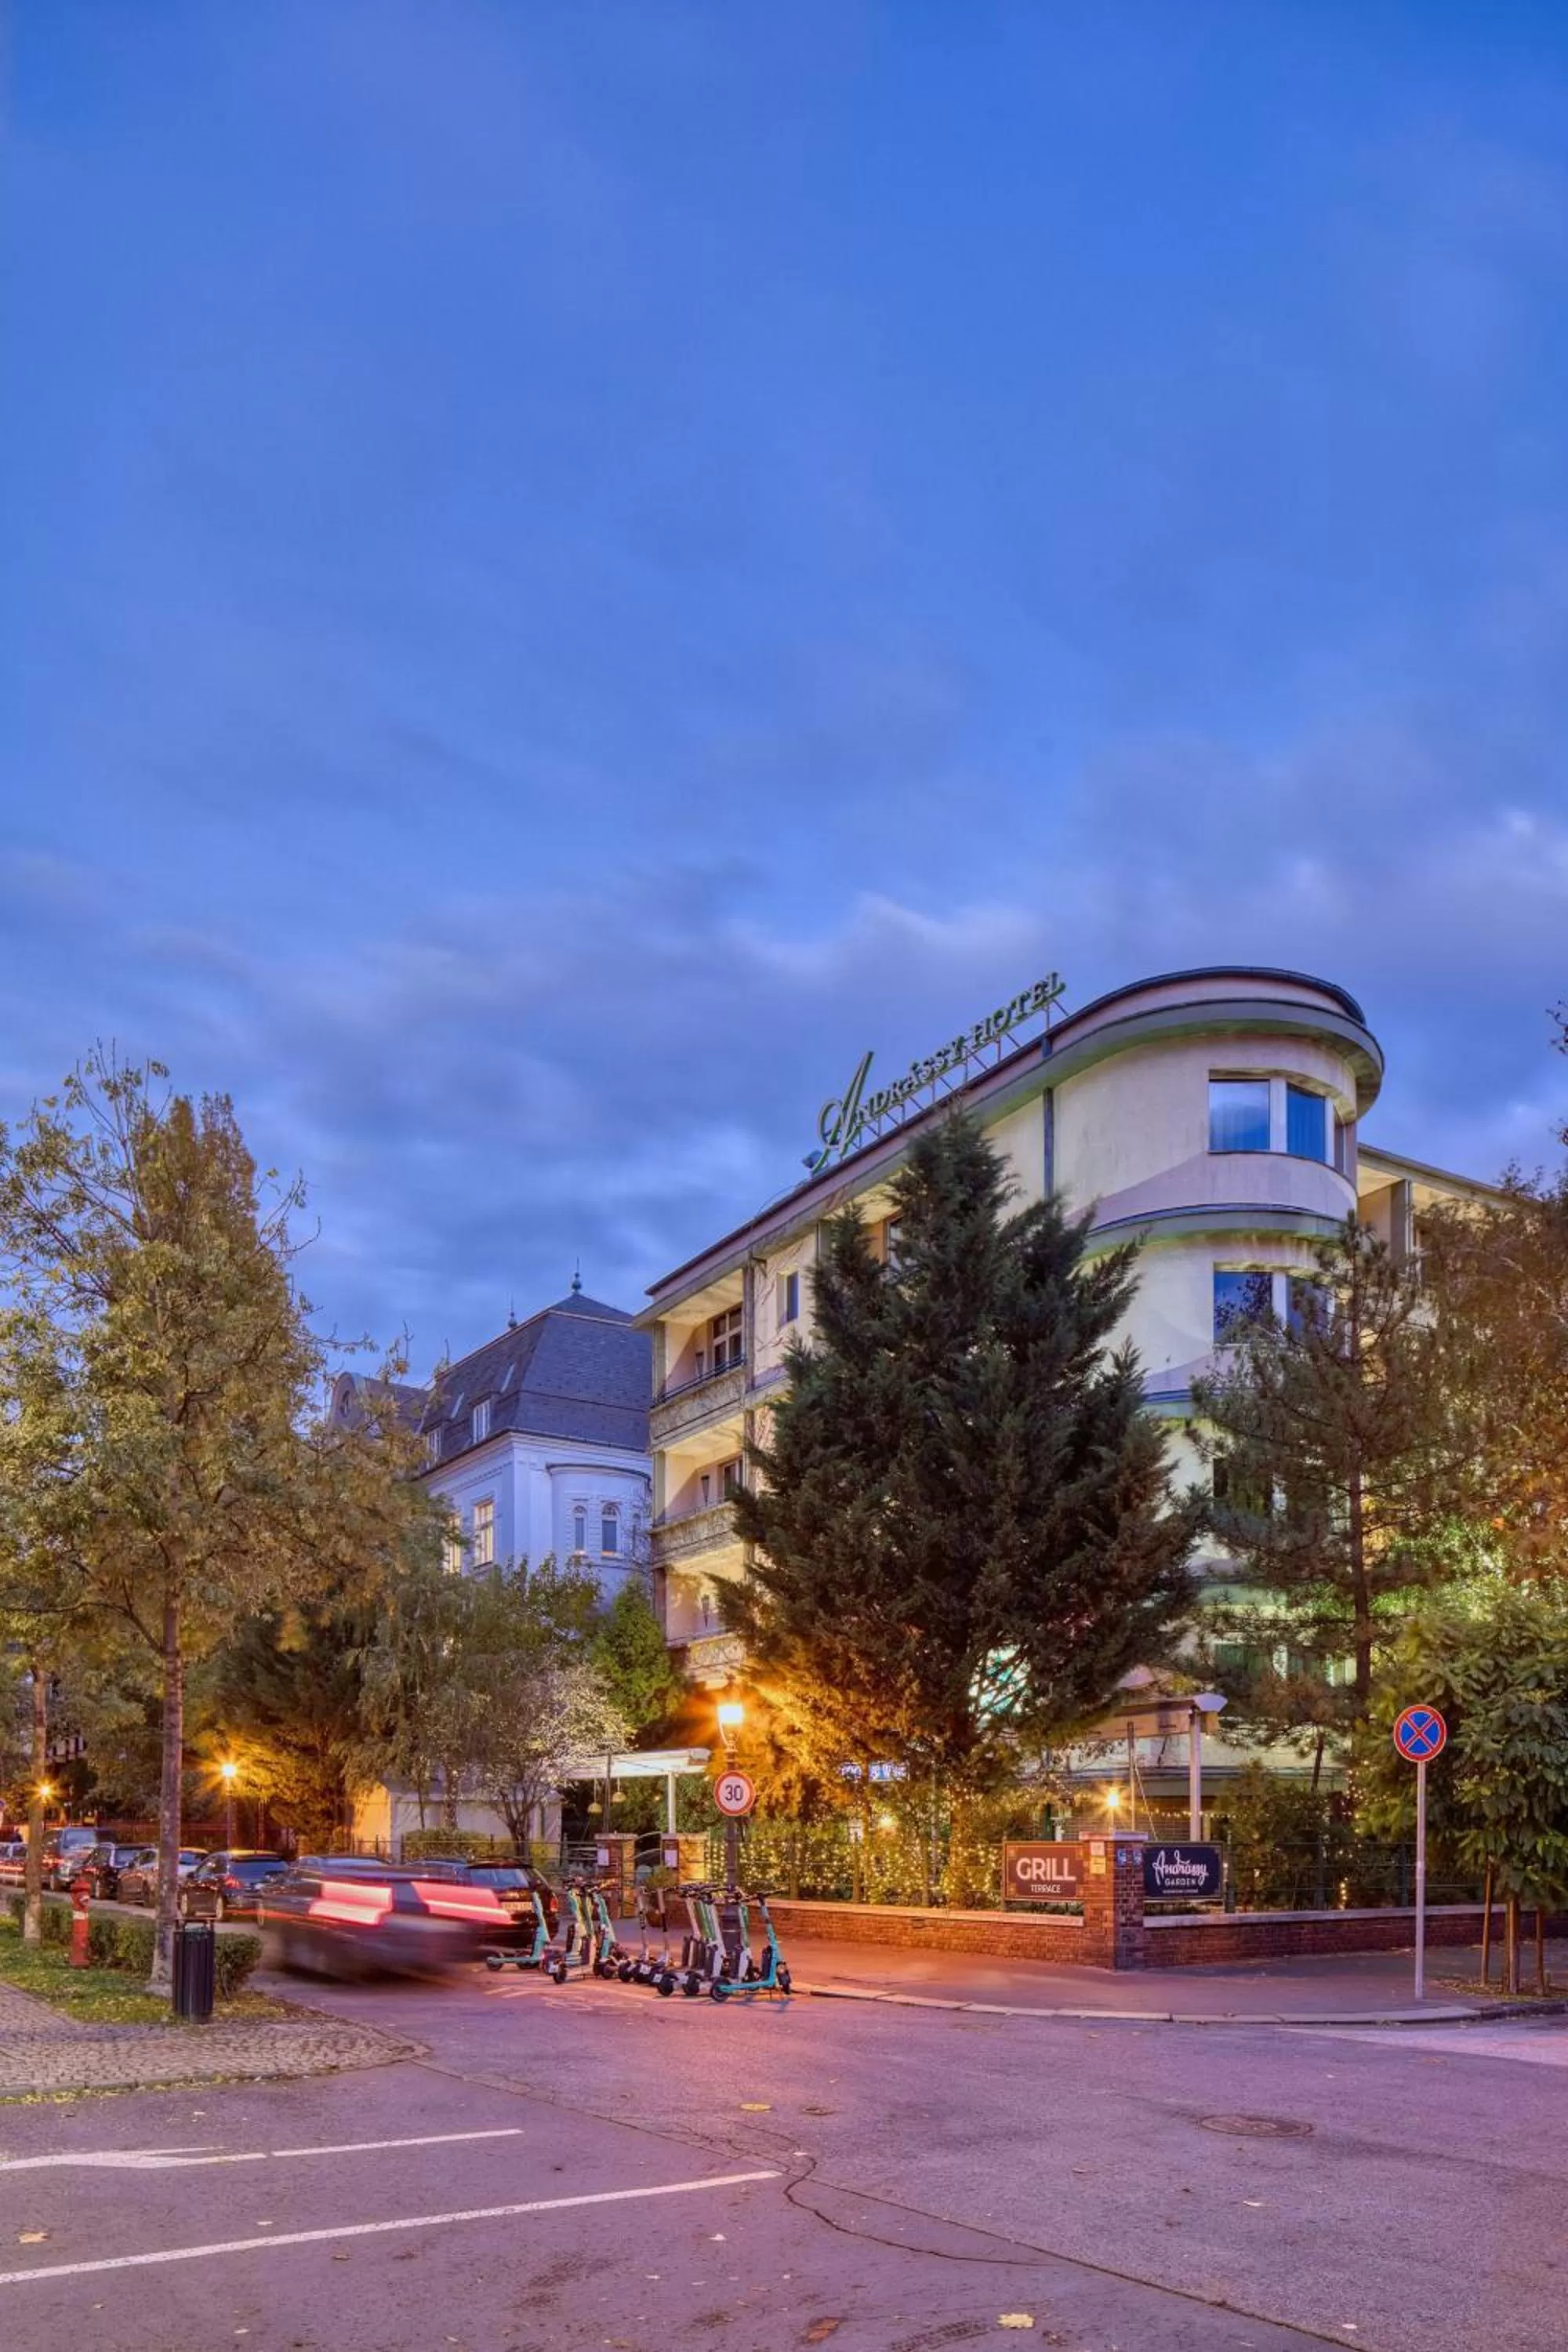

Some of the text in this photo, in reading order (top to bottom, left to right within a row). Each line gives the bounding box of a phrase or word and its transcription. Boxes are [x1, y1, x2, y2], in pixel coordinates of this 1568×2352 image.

[971, 971, 1066, 1047] HOTEL
[725, 1784, 744, 1801] 30
[1016, 1857, 1076, 1881] GRILL
[1030, 1884, 1062, 1893] TERRACE
[1164, 1878, 1196, 1886] GARDEN
